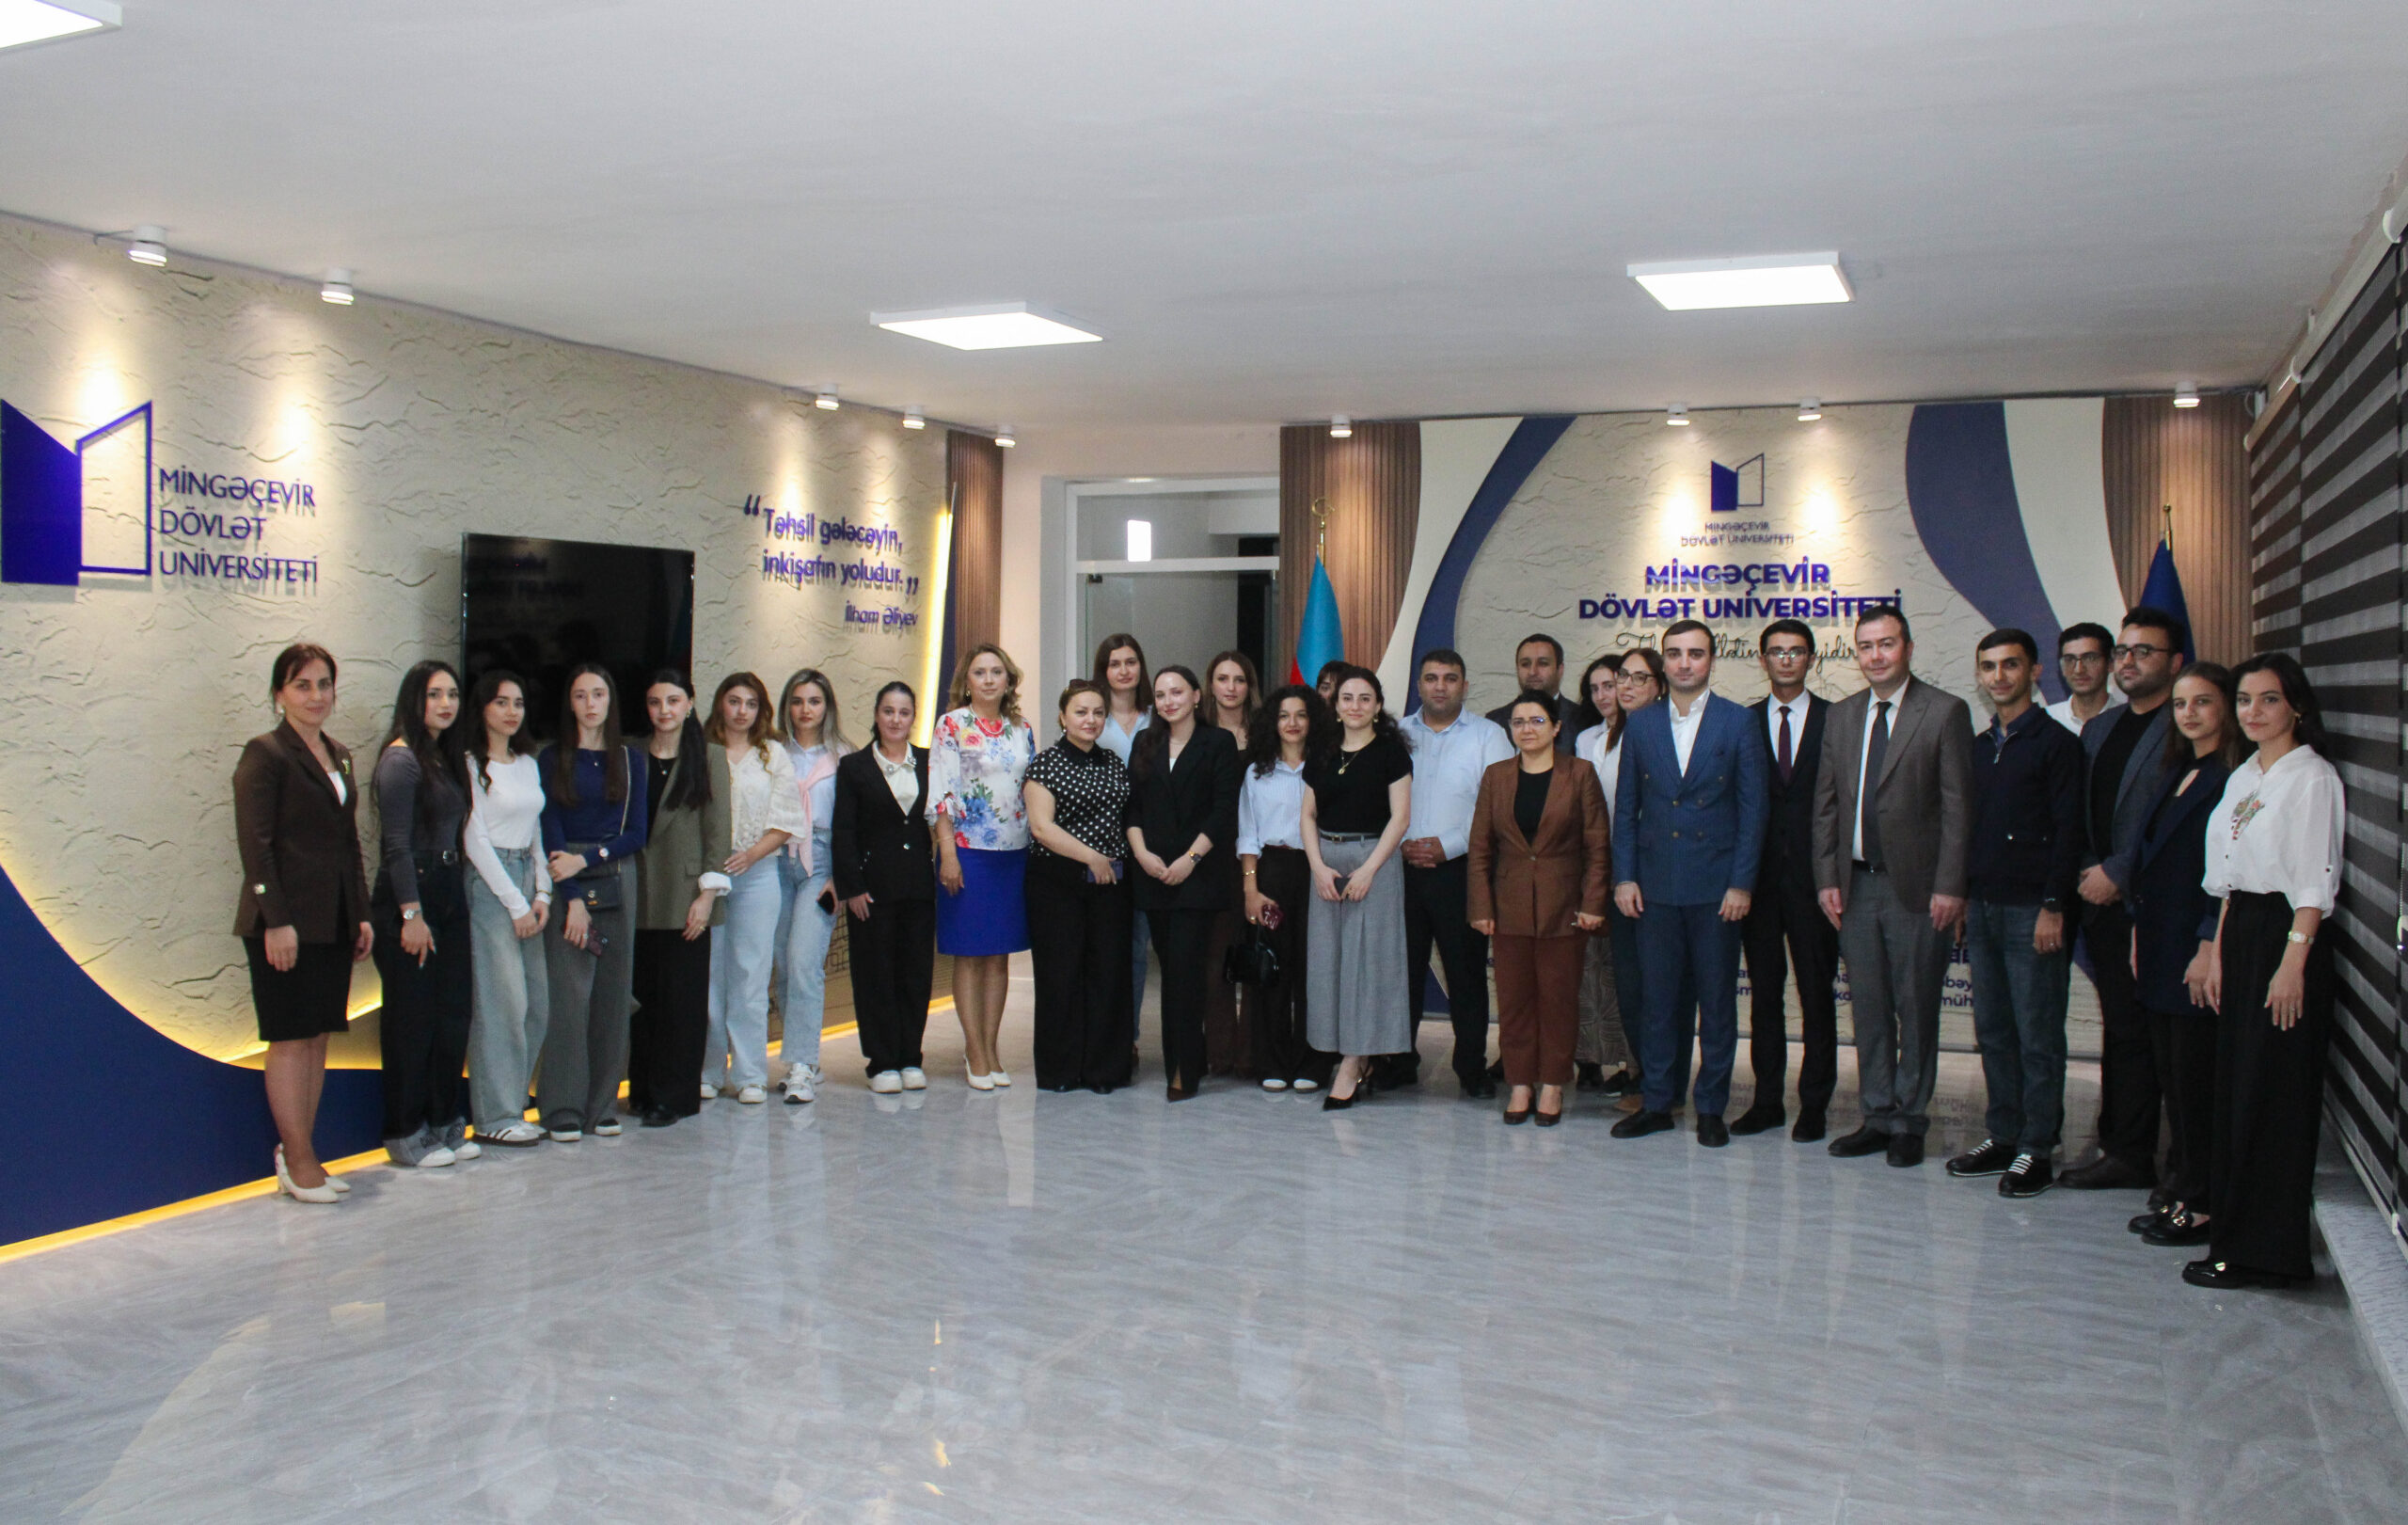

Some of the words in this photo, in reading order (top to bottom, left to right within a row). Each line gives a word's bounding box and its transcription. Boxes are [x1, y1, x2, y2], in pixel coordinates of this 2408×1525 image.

[159, 465, 316, 508] MİNGƏÇEVİR
[159, 506, 267, 540] DÖVLƏT
[159, 548, 318, 583] UNİVERSİTETİ
[1645, 556, 1830, 590] MİNGƏÇEVİR
[1579, 593, 1695, 619] DÖVLƏT
